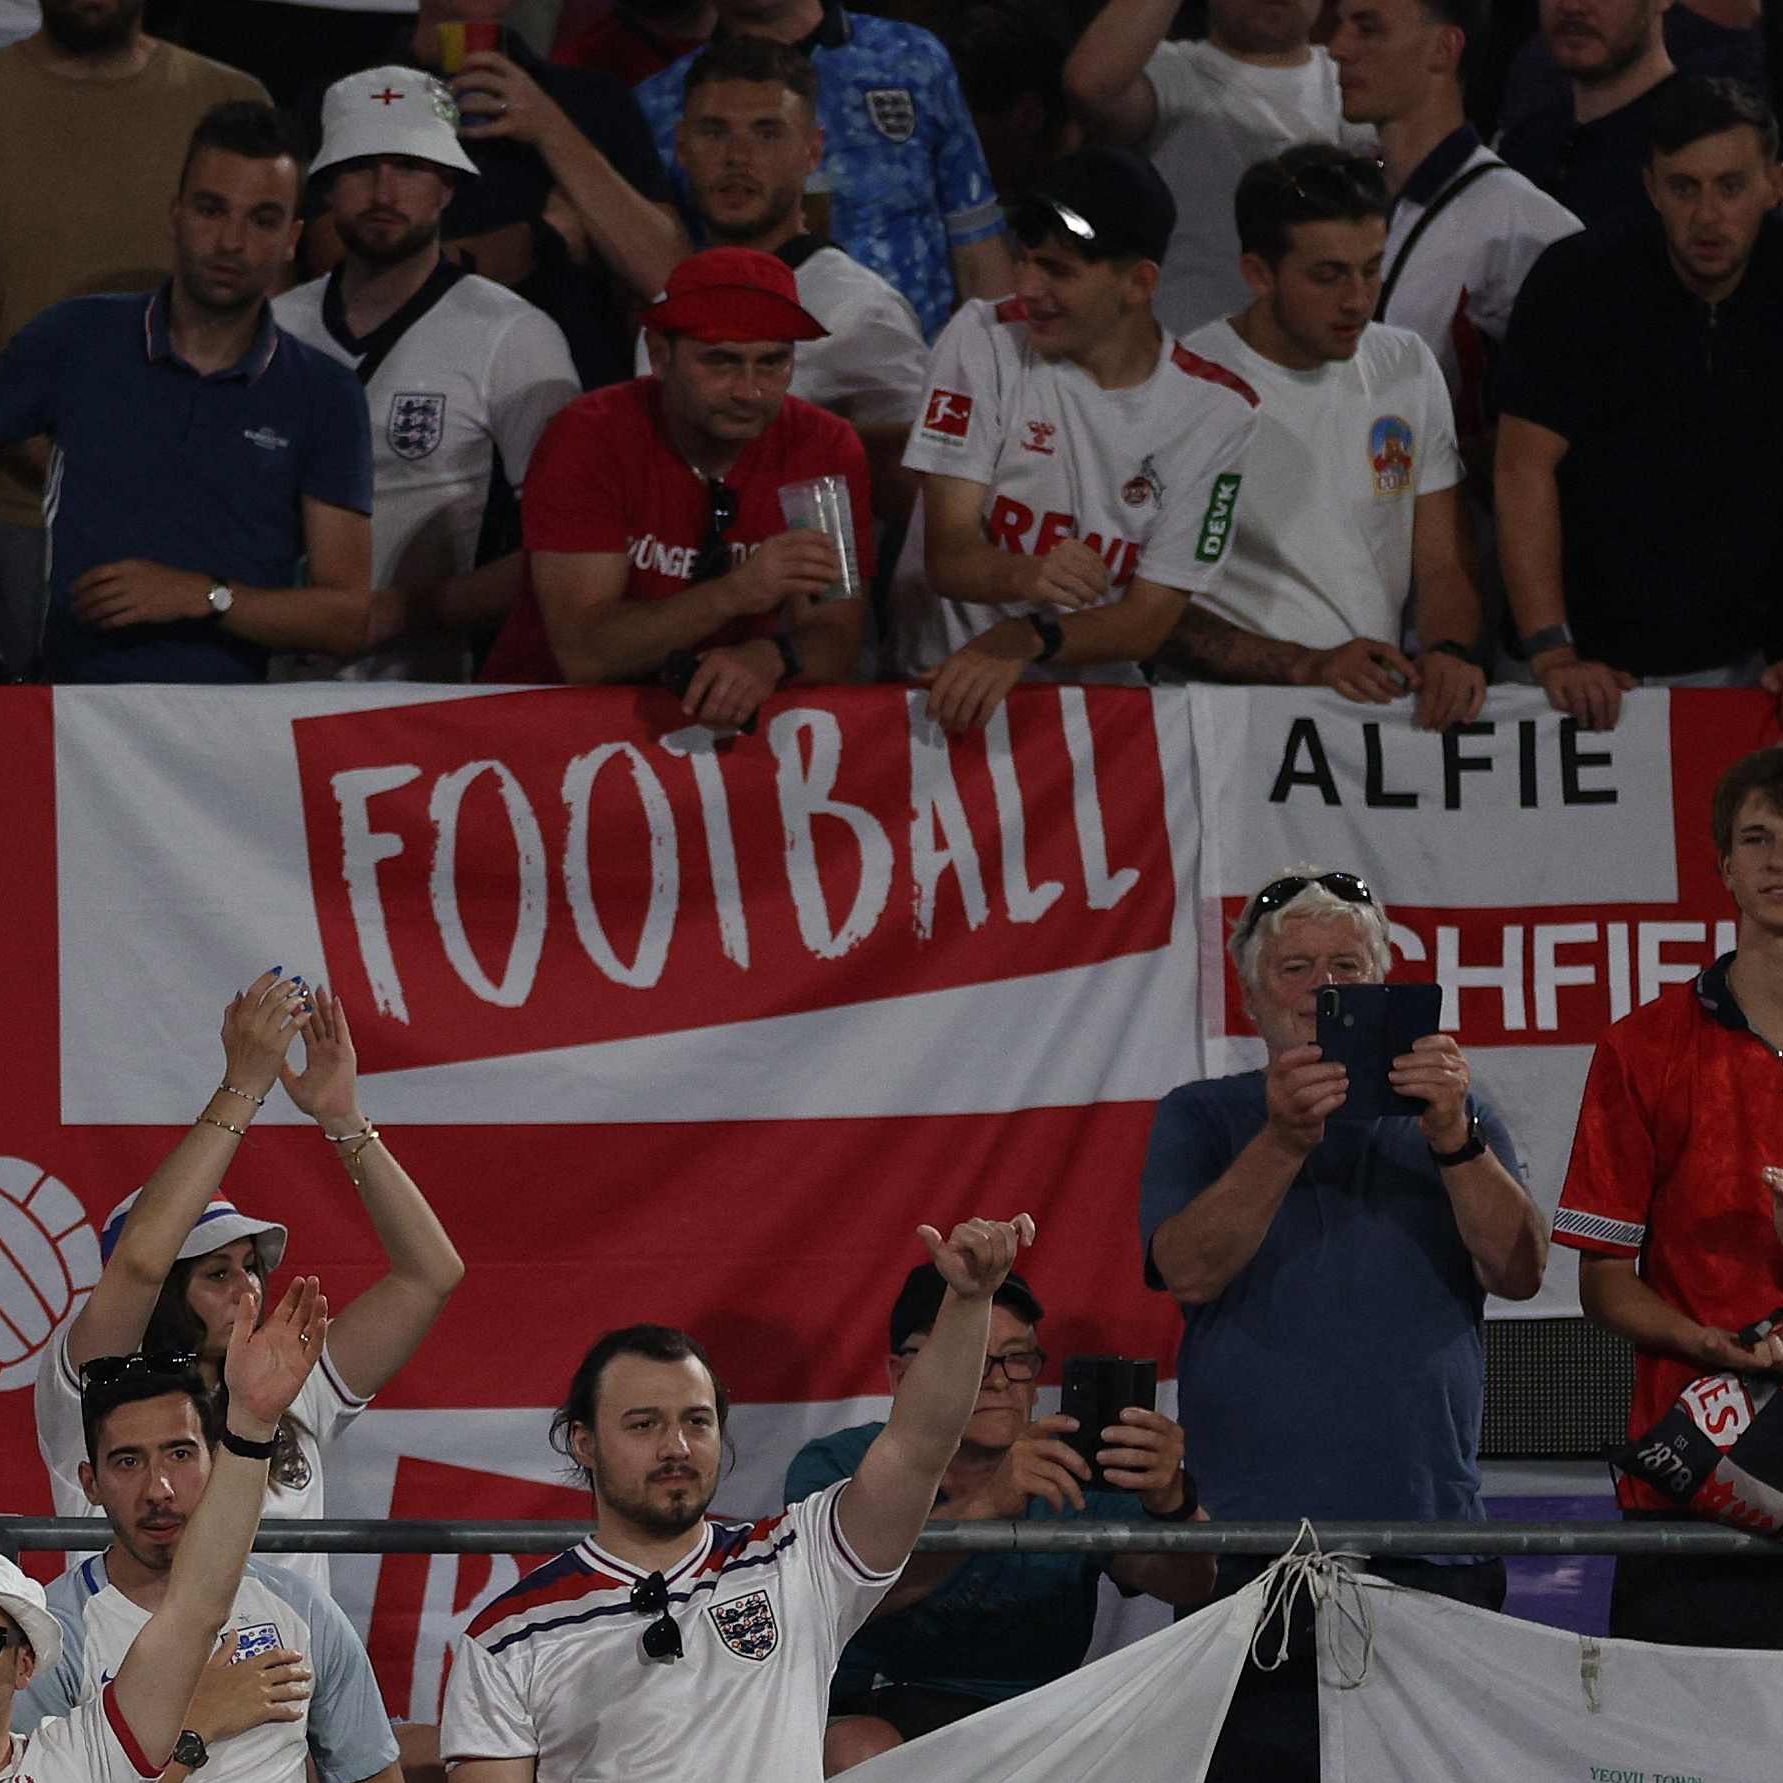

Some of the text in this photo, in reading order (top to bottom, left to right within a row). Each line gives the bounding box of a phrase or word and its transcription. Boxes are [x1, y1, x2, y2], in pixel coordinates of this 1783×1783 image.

[1203, 480, 1240, 556] DEVK
[1269, 716, 1618, 810] ALFIE
[329, 686, 1141, 1026] FOOTBALL
[1637, 1441, 1694, 1494] 1878
